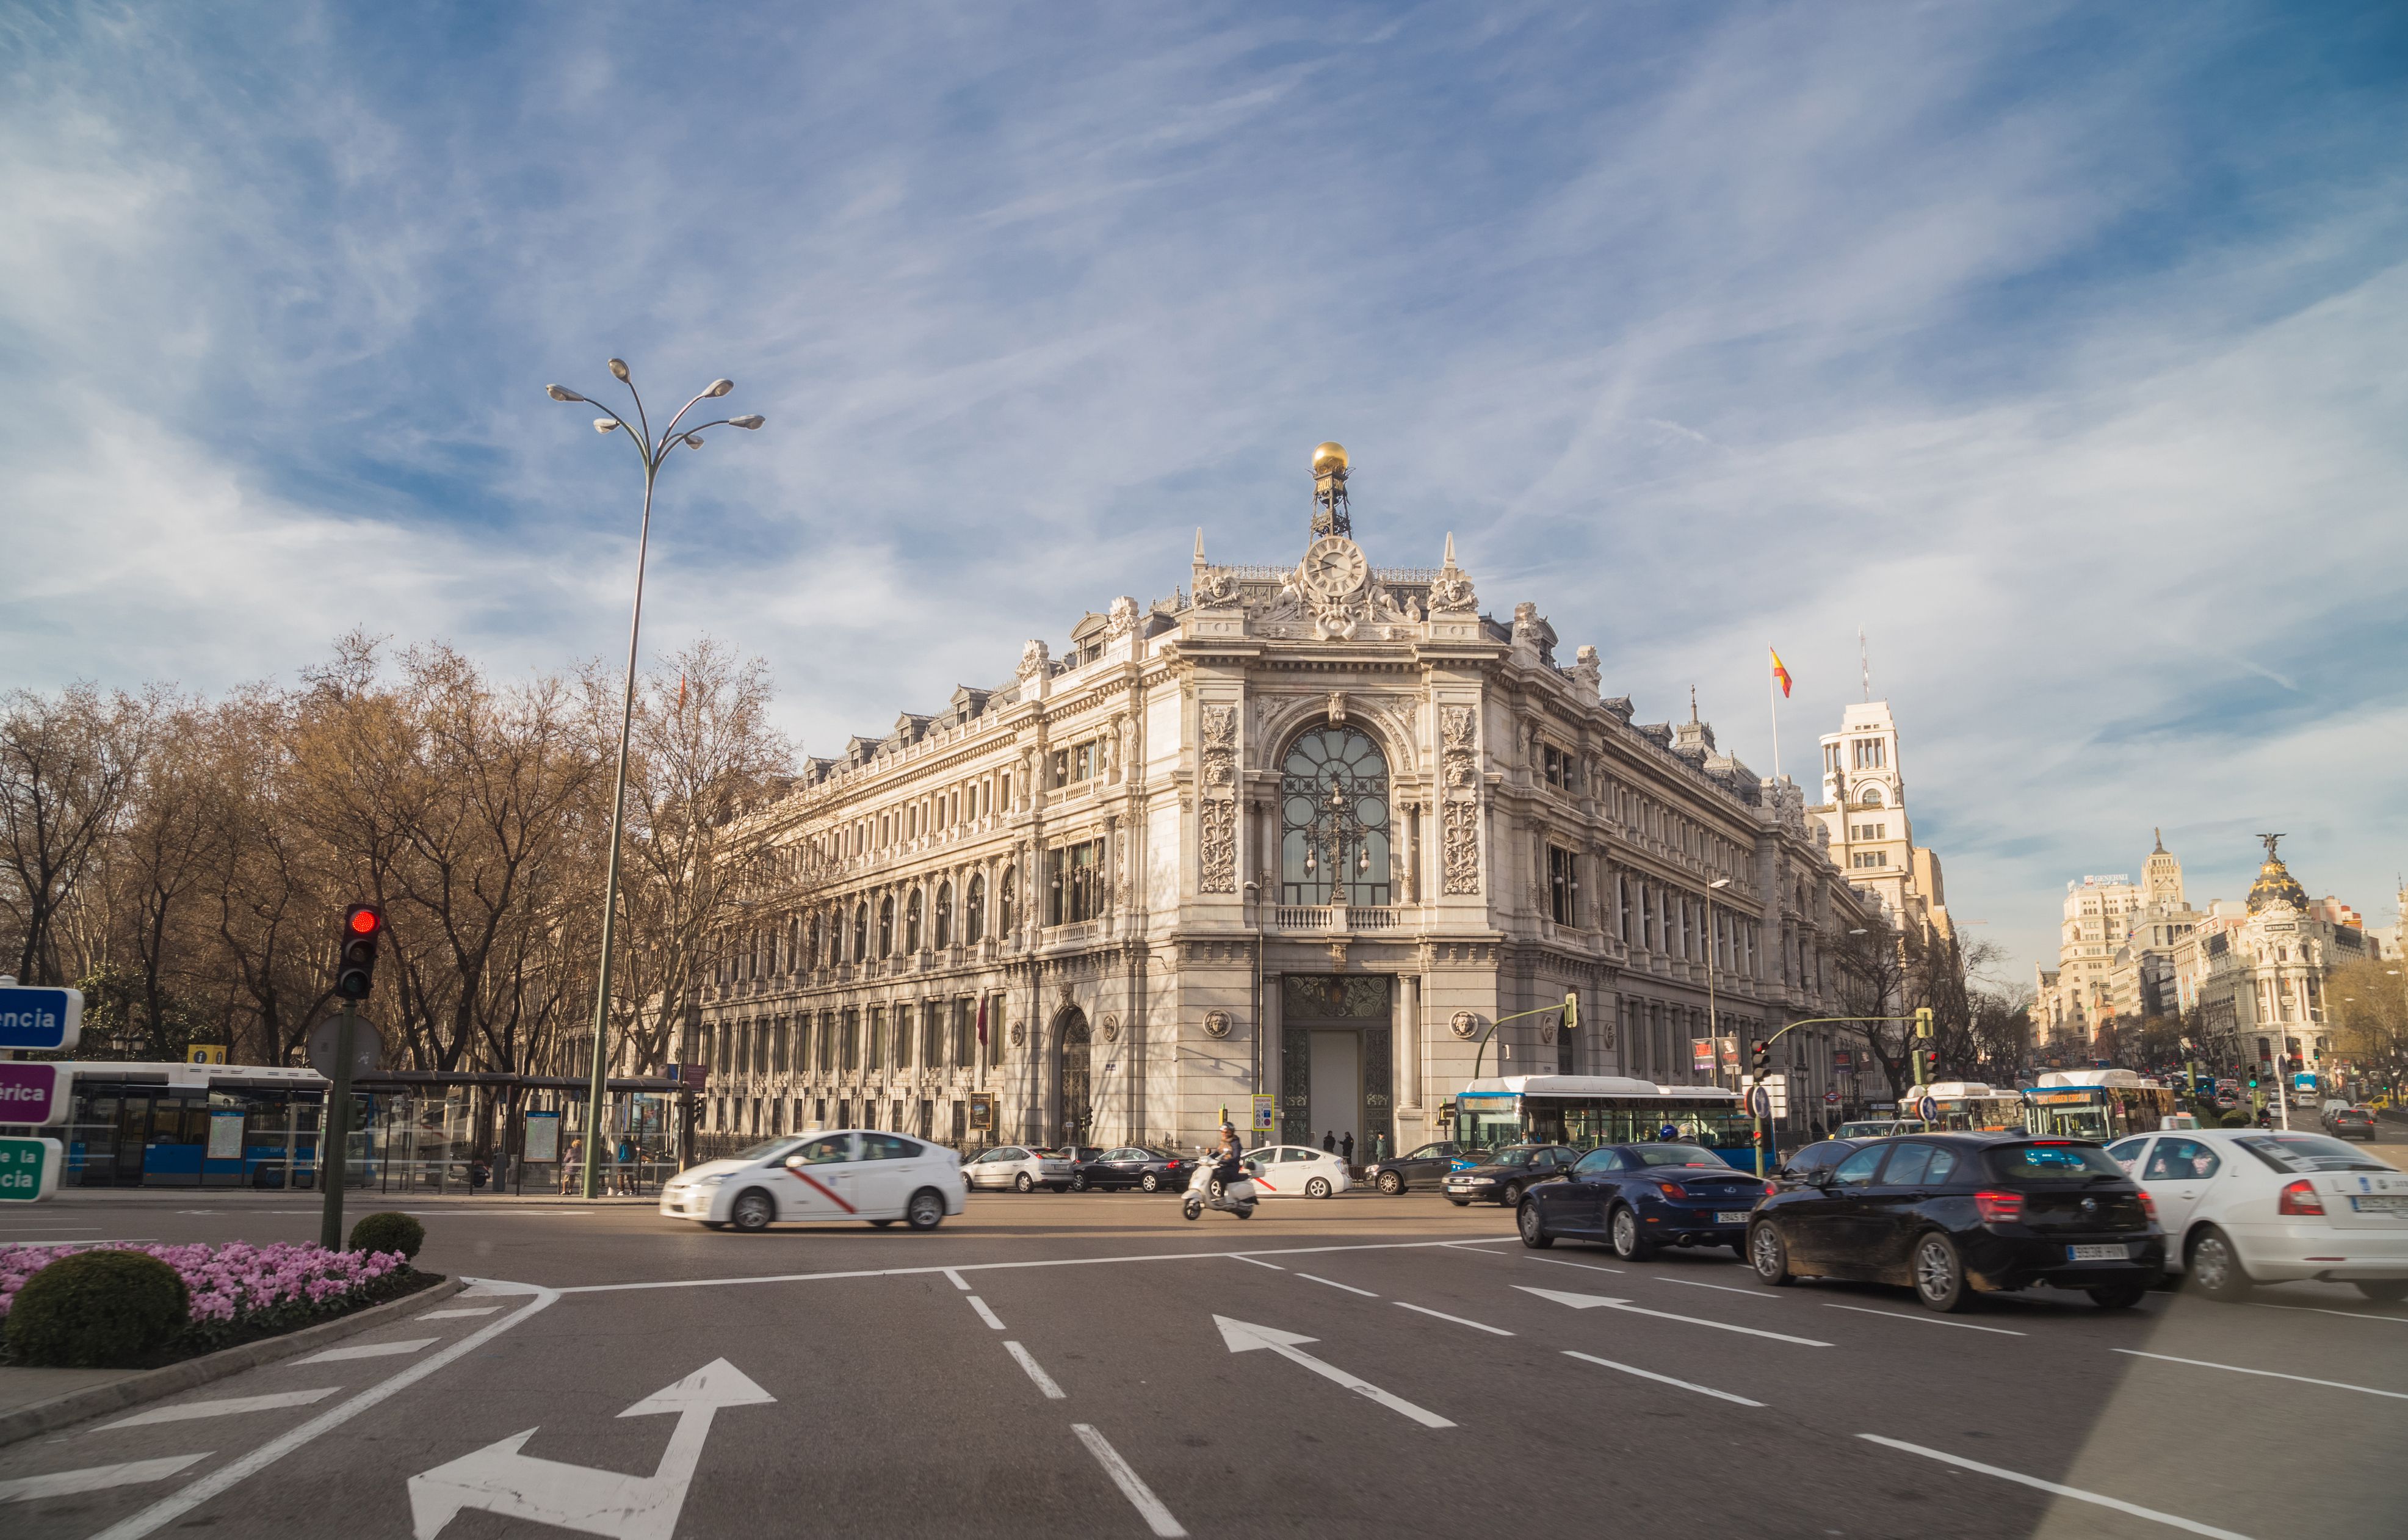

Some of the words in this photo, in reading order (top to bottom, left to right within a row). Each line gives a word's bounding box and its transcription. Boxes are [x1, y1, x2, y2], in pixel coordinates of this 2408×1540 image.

[1317, 478, 1331, 492] BANCO
[0, 1008, 56, 1027] ncia
[2036, 1094, 2048, 1105] 150
[0, 1150, 11, 1163] e
[20, 1150, 37, 1163] la
[0, 1169, 34, 1188] cia
[1721, 1213, 1738, 1221] 2845
